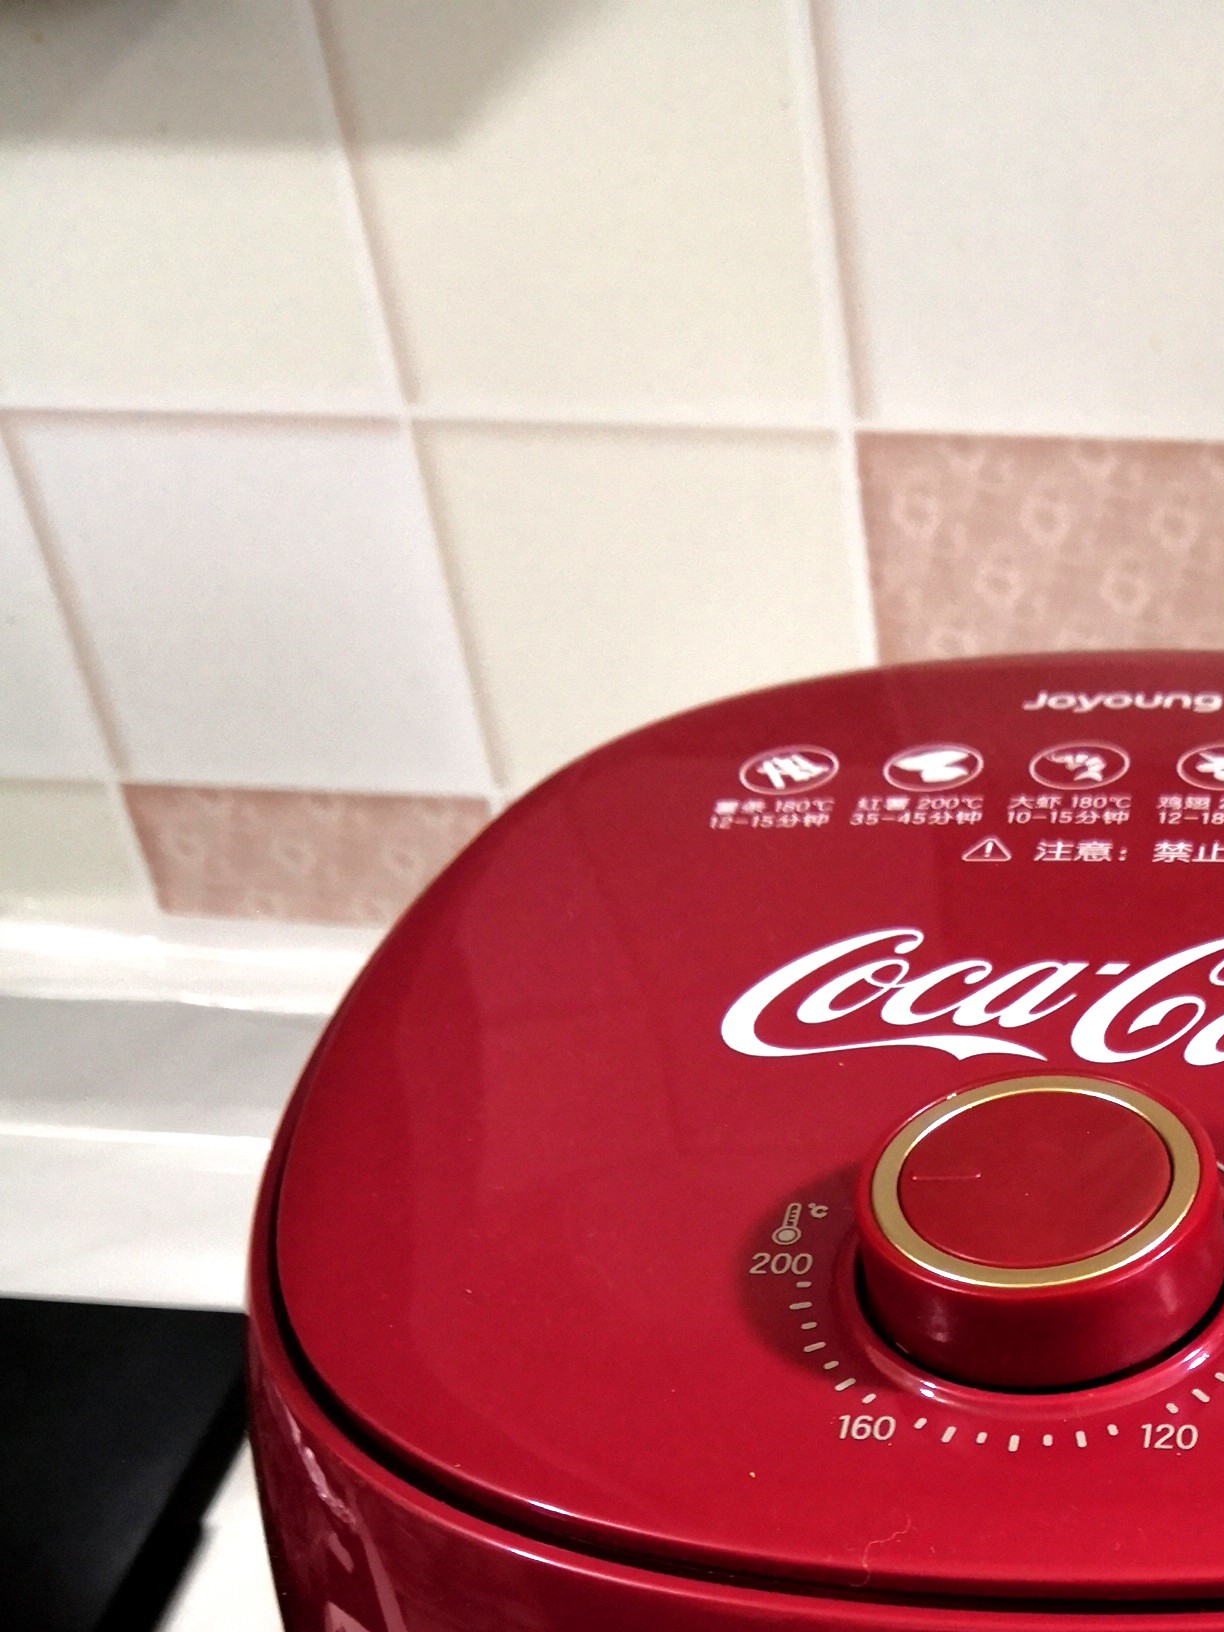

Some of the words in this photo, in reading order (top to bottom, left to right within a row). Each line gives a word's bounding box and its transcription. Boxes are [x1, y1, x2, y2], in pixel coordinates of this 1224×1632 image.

[1022, 687, 1224, 714] Joyoung
[1007, 811, 1131, 825] 10-15分钟
[749, 1252, 813, 1275] 200
[837, 1414, 896, 1441] 160
[1140, 1422, 1199, 1451] 120
